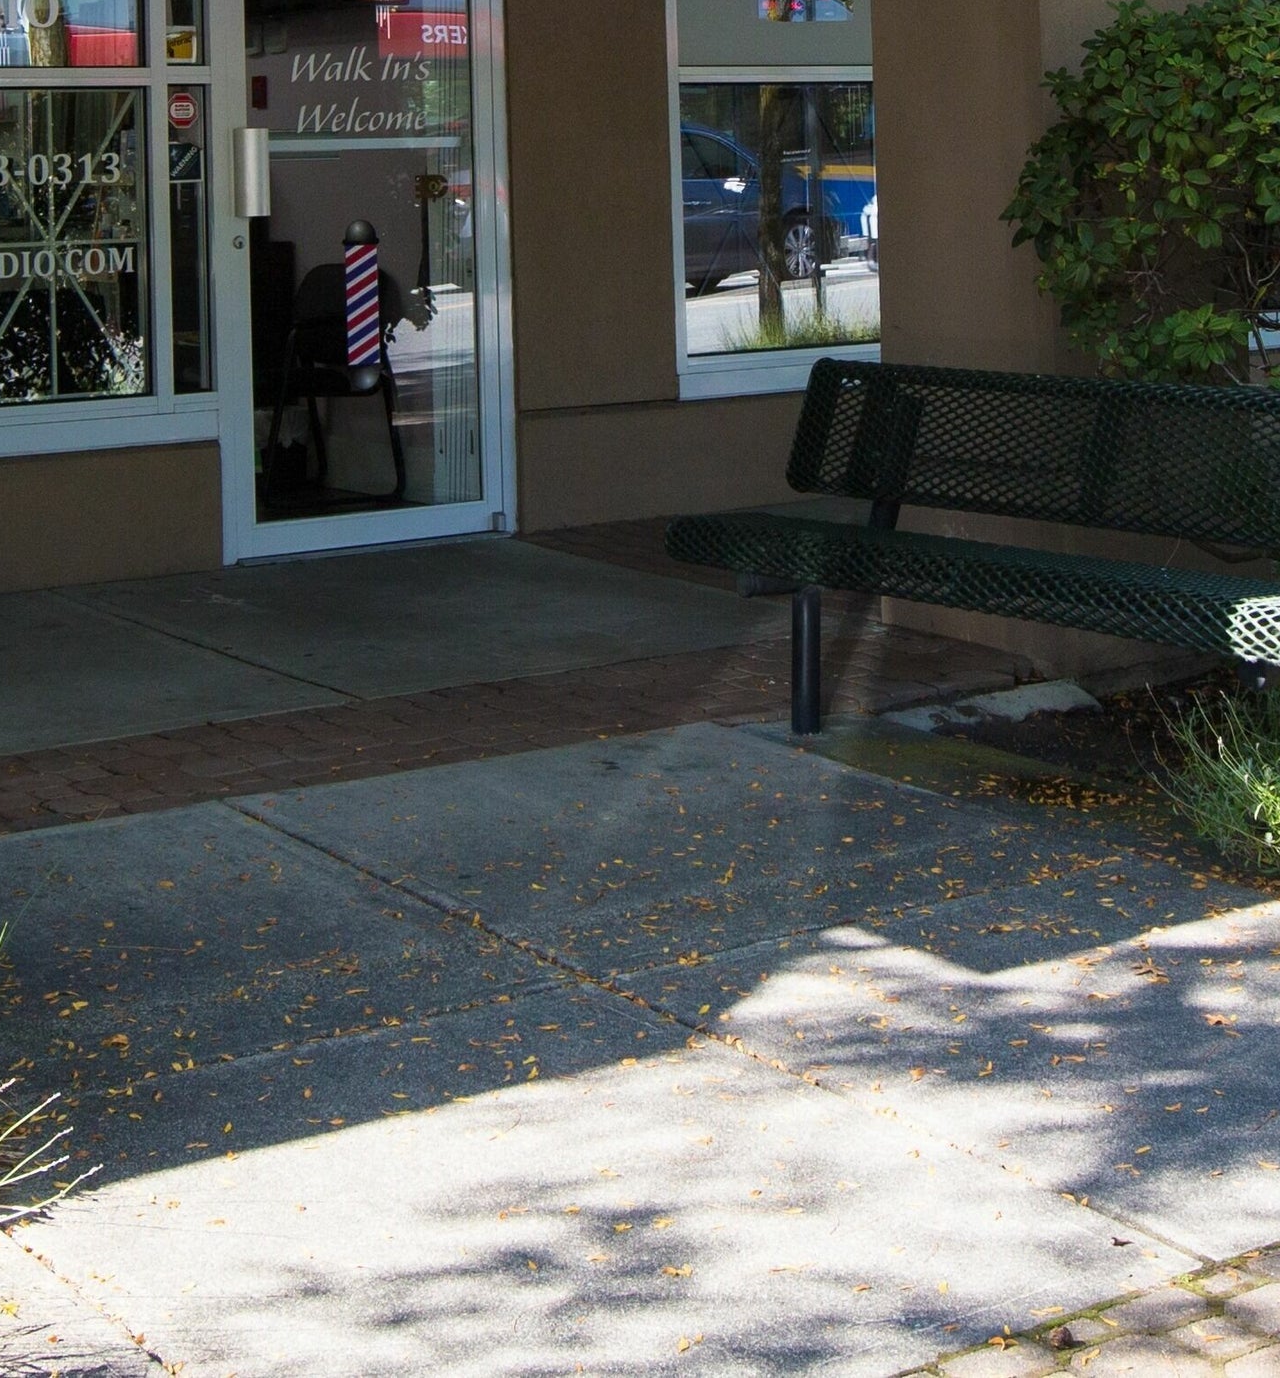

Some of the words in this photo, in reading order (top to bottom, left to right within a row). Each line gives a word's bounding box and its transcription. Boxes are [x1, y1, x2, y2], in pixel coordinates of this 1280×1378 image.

[290, 46, 372, 84] Walk
[380, 49, 432, 83] In's
[296, 96, 428, 135] Welcome
[170, 146, 198, 177] WARNING
